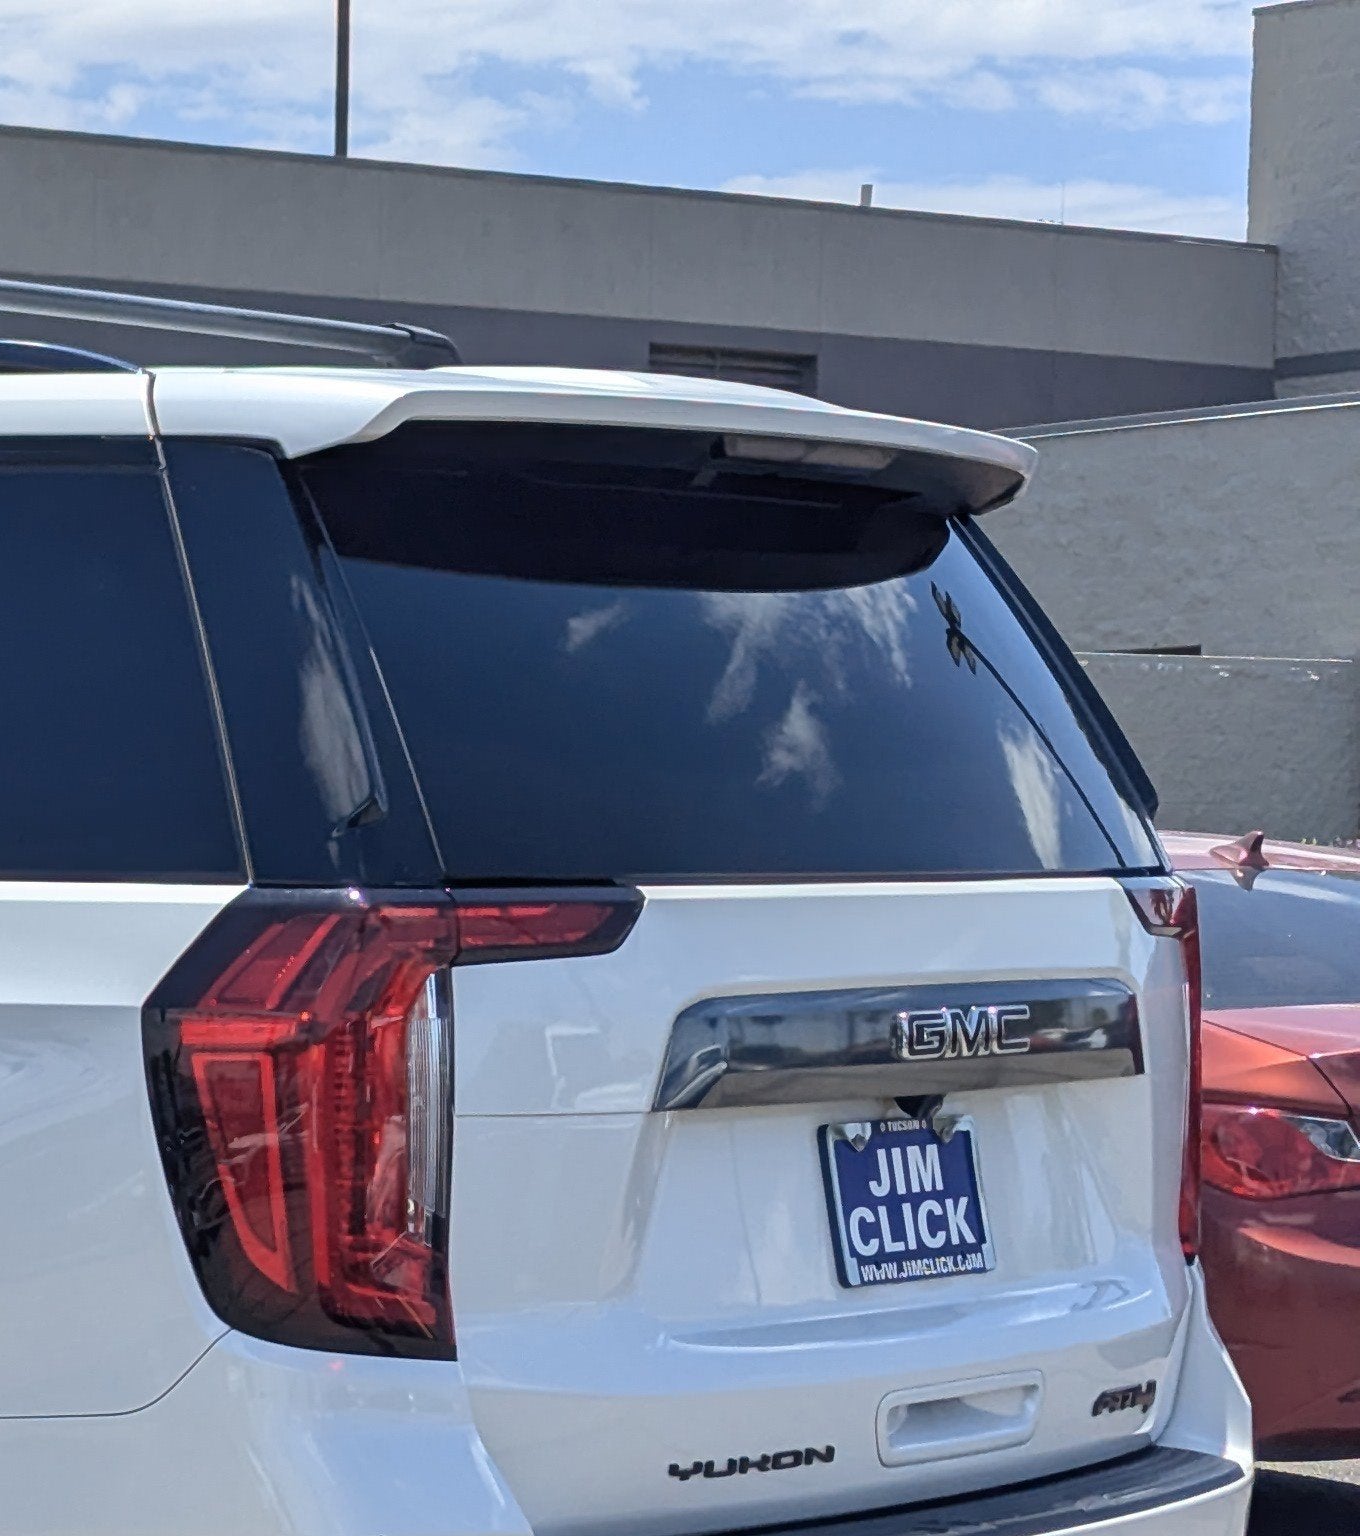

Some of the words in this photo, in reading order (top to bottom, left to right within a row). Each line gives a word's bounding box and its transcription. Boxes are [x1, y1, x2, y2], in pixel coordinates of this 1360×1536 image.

[894, 1004, 1030, 1060] GMC
[868, 1143, 944, 1198] JIM
[849, 1196, 977, 1257] CLICK
[668, 1445, 836, 1481] YUKON
